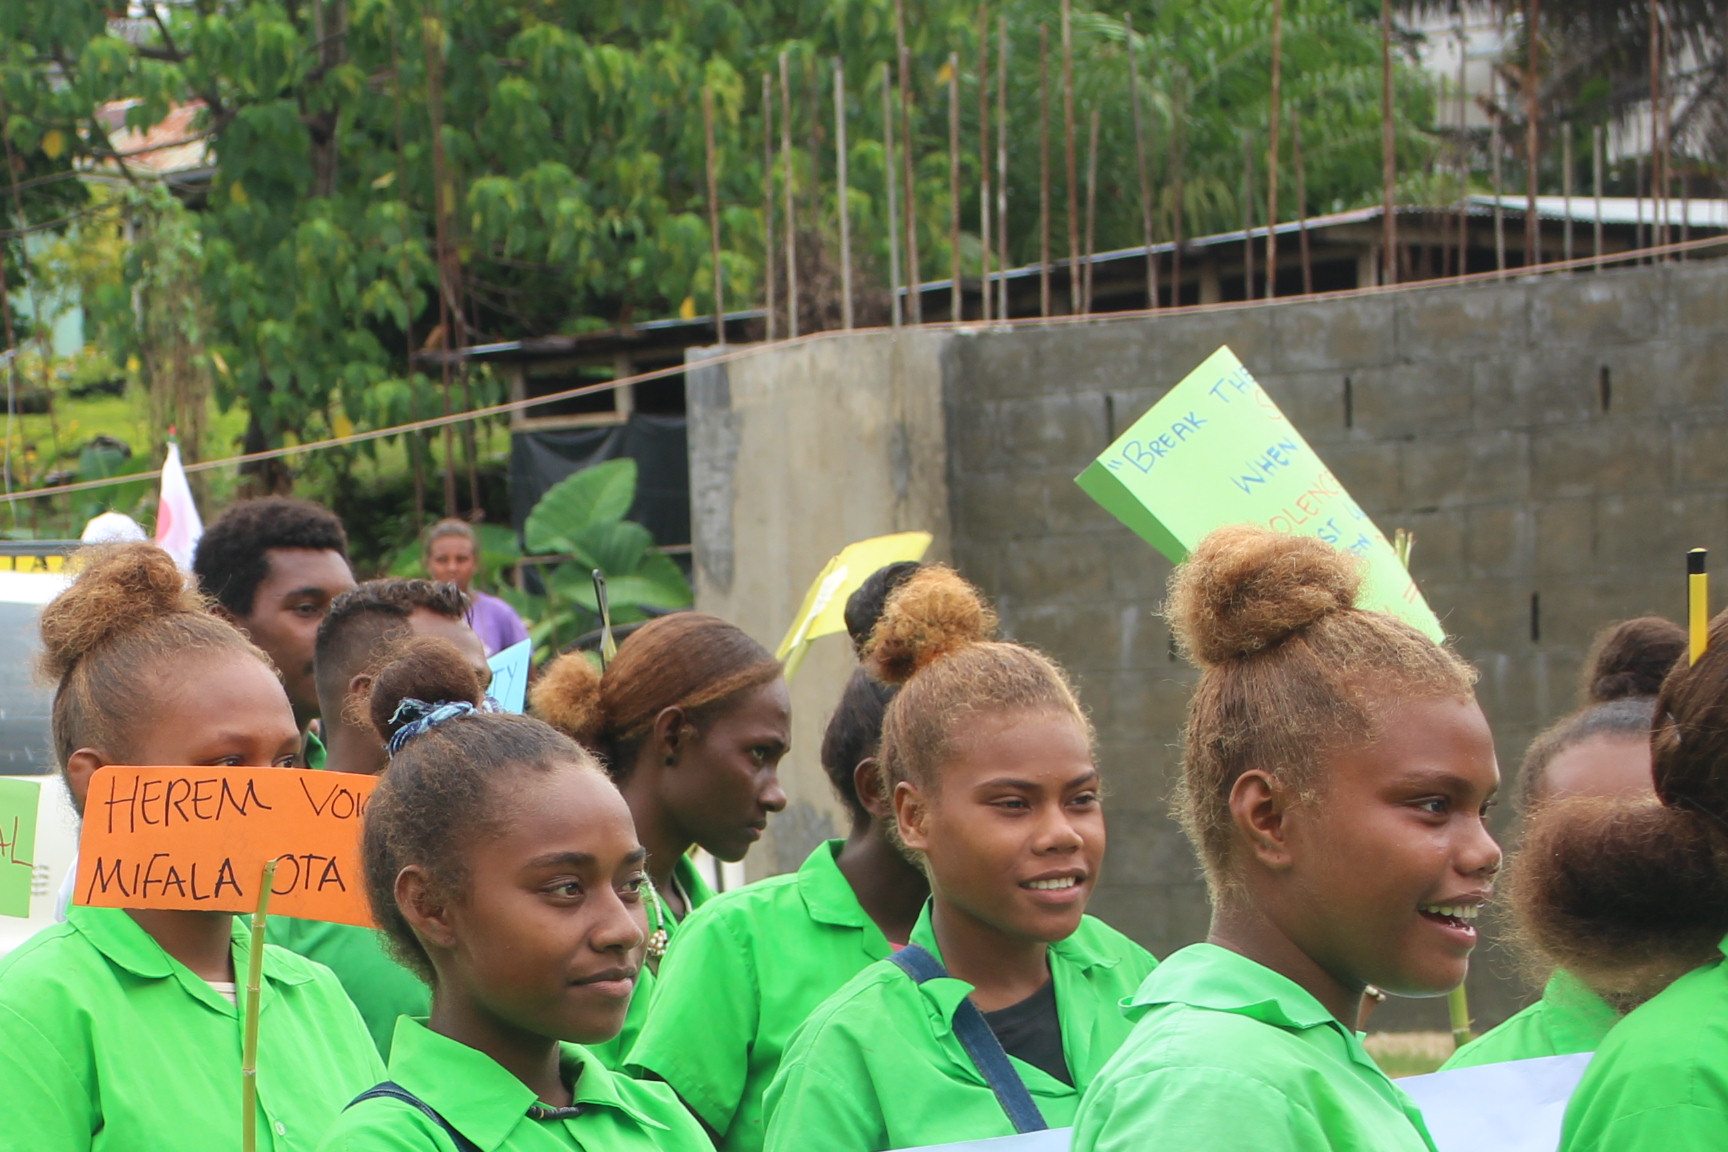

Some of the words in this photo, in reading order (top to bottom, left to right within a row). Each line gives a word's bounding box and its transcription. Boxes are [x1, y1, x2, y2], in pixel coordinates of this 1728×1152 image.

[1230, 436, 1300, 494] WHEN
[104, 775, 272, 833] HEREM
[86, 853, 243, 904] MIFALA
[271, 853, 346, 895] OTA
